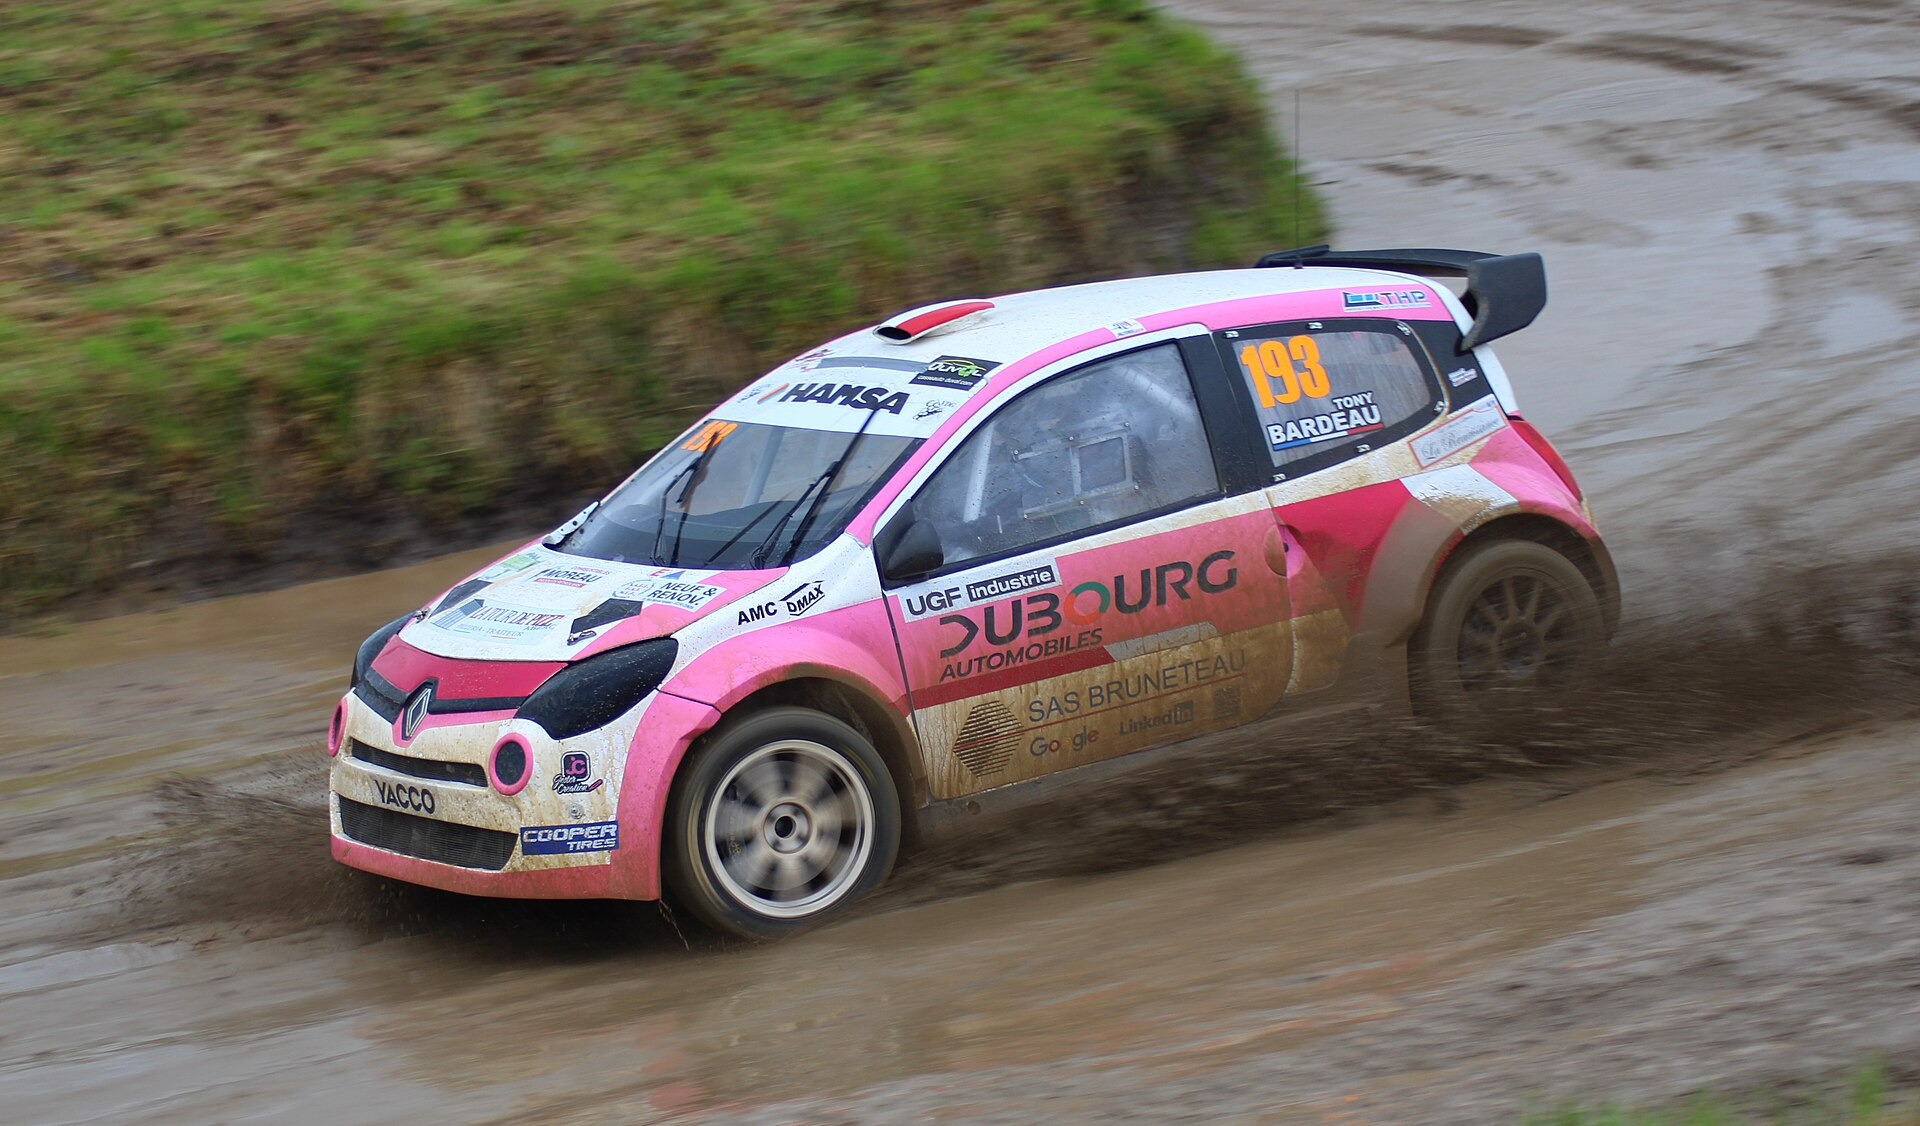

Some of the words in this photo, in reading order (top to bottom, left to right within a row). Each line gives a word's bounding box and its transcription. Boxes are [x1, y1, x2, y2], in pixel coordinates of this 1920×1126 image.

[1379, 290, 1426, 305] THP
[1239, 335, 1331, 409] 193
[778, 383, 910, 415] HAMSA
[1332, 391, 1374, 411] TONY
[1267, 404, 1382, 445] BARDEAU
[543, 569, 602, 583] MOREAU
[660, 581, 705, 593] NEUF
[703, 587, 718, 597] &
[647, 589, 705, 606] RENOV.
[786, 583, 824, 613] DMAX
[906, 586, 962, 616] UGF
[969, 569, 1053, 602] industrie
[939, 550, 1238, 659] DUBOURG
[737, 601, 778, 626] AMC
[939, 627, 1103, 683] AUTOMOBILES
[1028, 691, 1080, 723] SAS
[1088, 650, 1246, 709] BRUNETEAU
[1029, 725, 1100, 757] Gogle
[374, 778, 436, 815] YACCO
[522, 825, 618, 844] COOPER
[566, 837, 617, 852] TIRES
